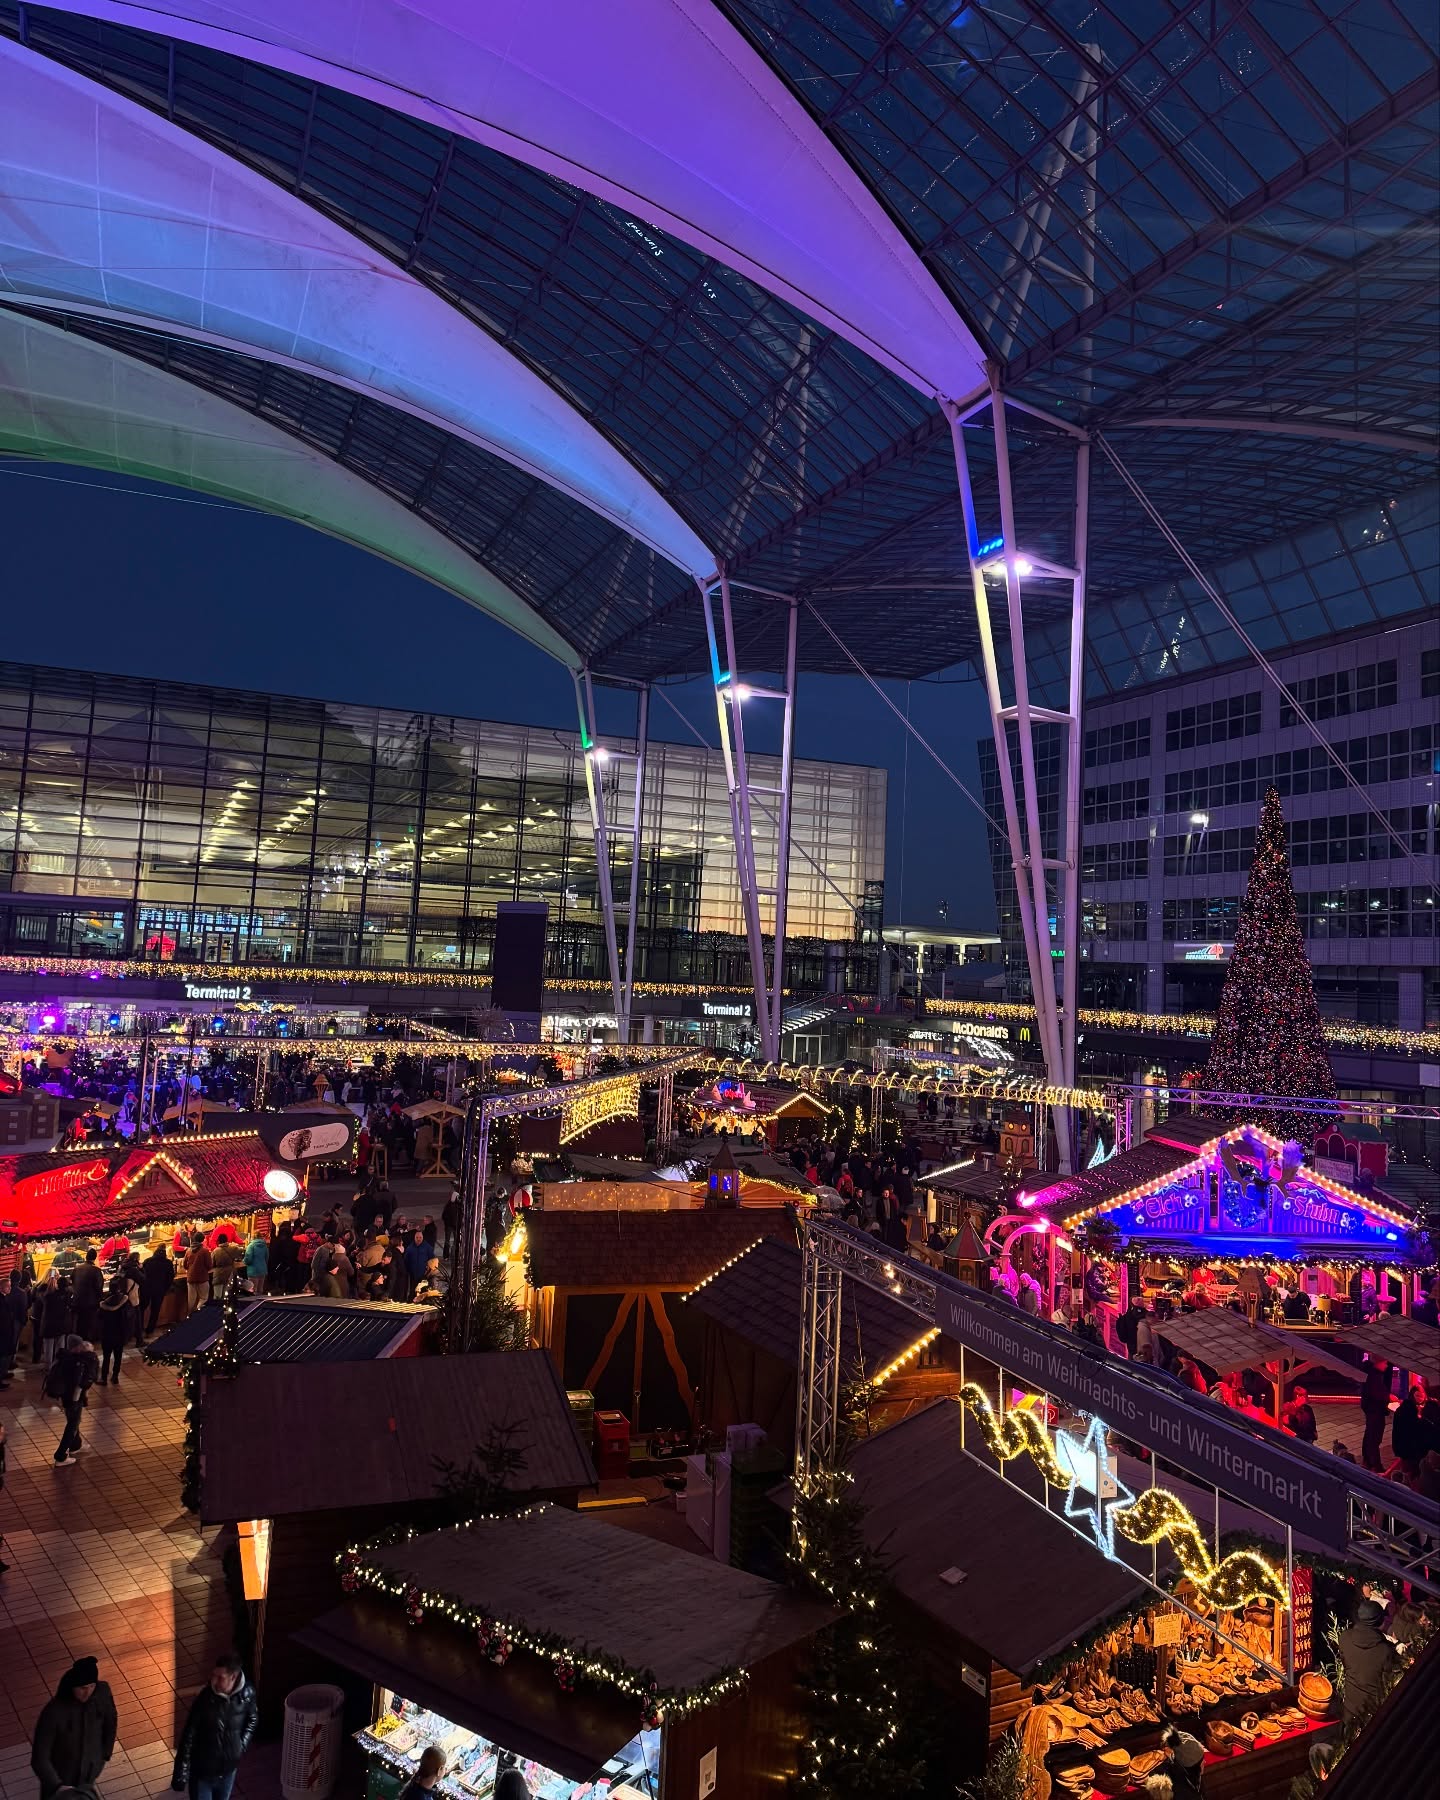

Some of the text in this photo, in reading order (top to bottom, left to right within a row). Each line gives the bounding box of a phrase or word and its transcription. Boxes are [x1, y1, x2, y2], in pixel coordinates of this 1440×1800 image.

[185, 984, 251, 1000] Terminal 2
[703, 1002, 751, 1016] Terminal 2
[952, 1021, 1009, 1040] McDonald's
[1145, 1193, 1185, 1218] Elch
[950, 1303, 1322, 1519] Willkommen am Weihnachts- und Wintermarkt
